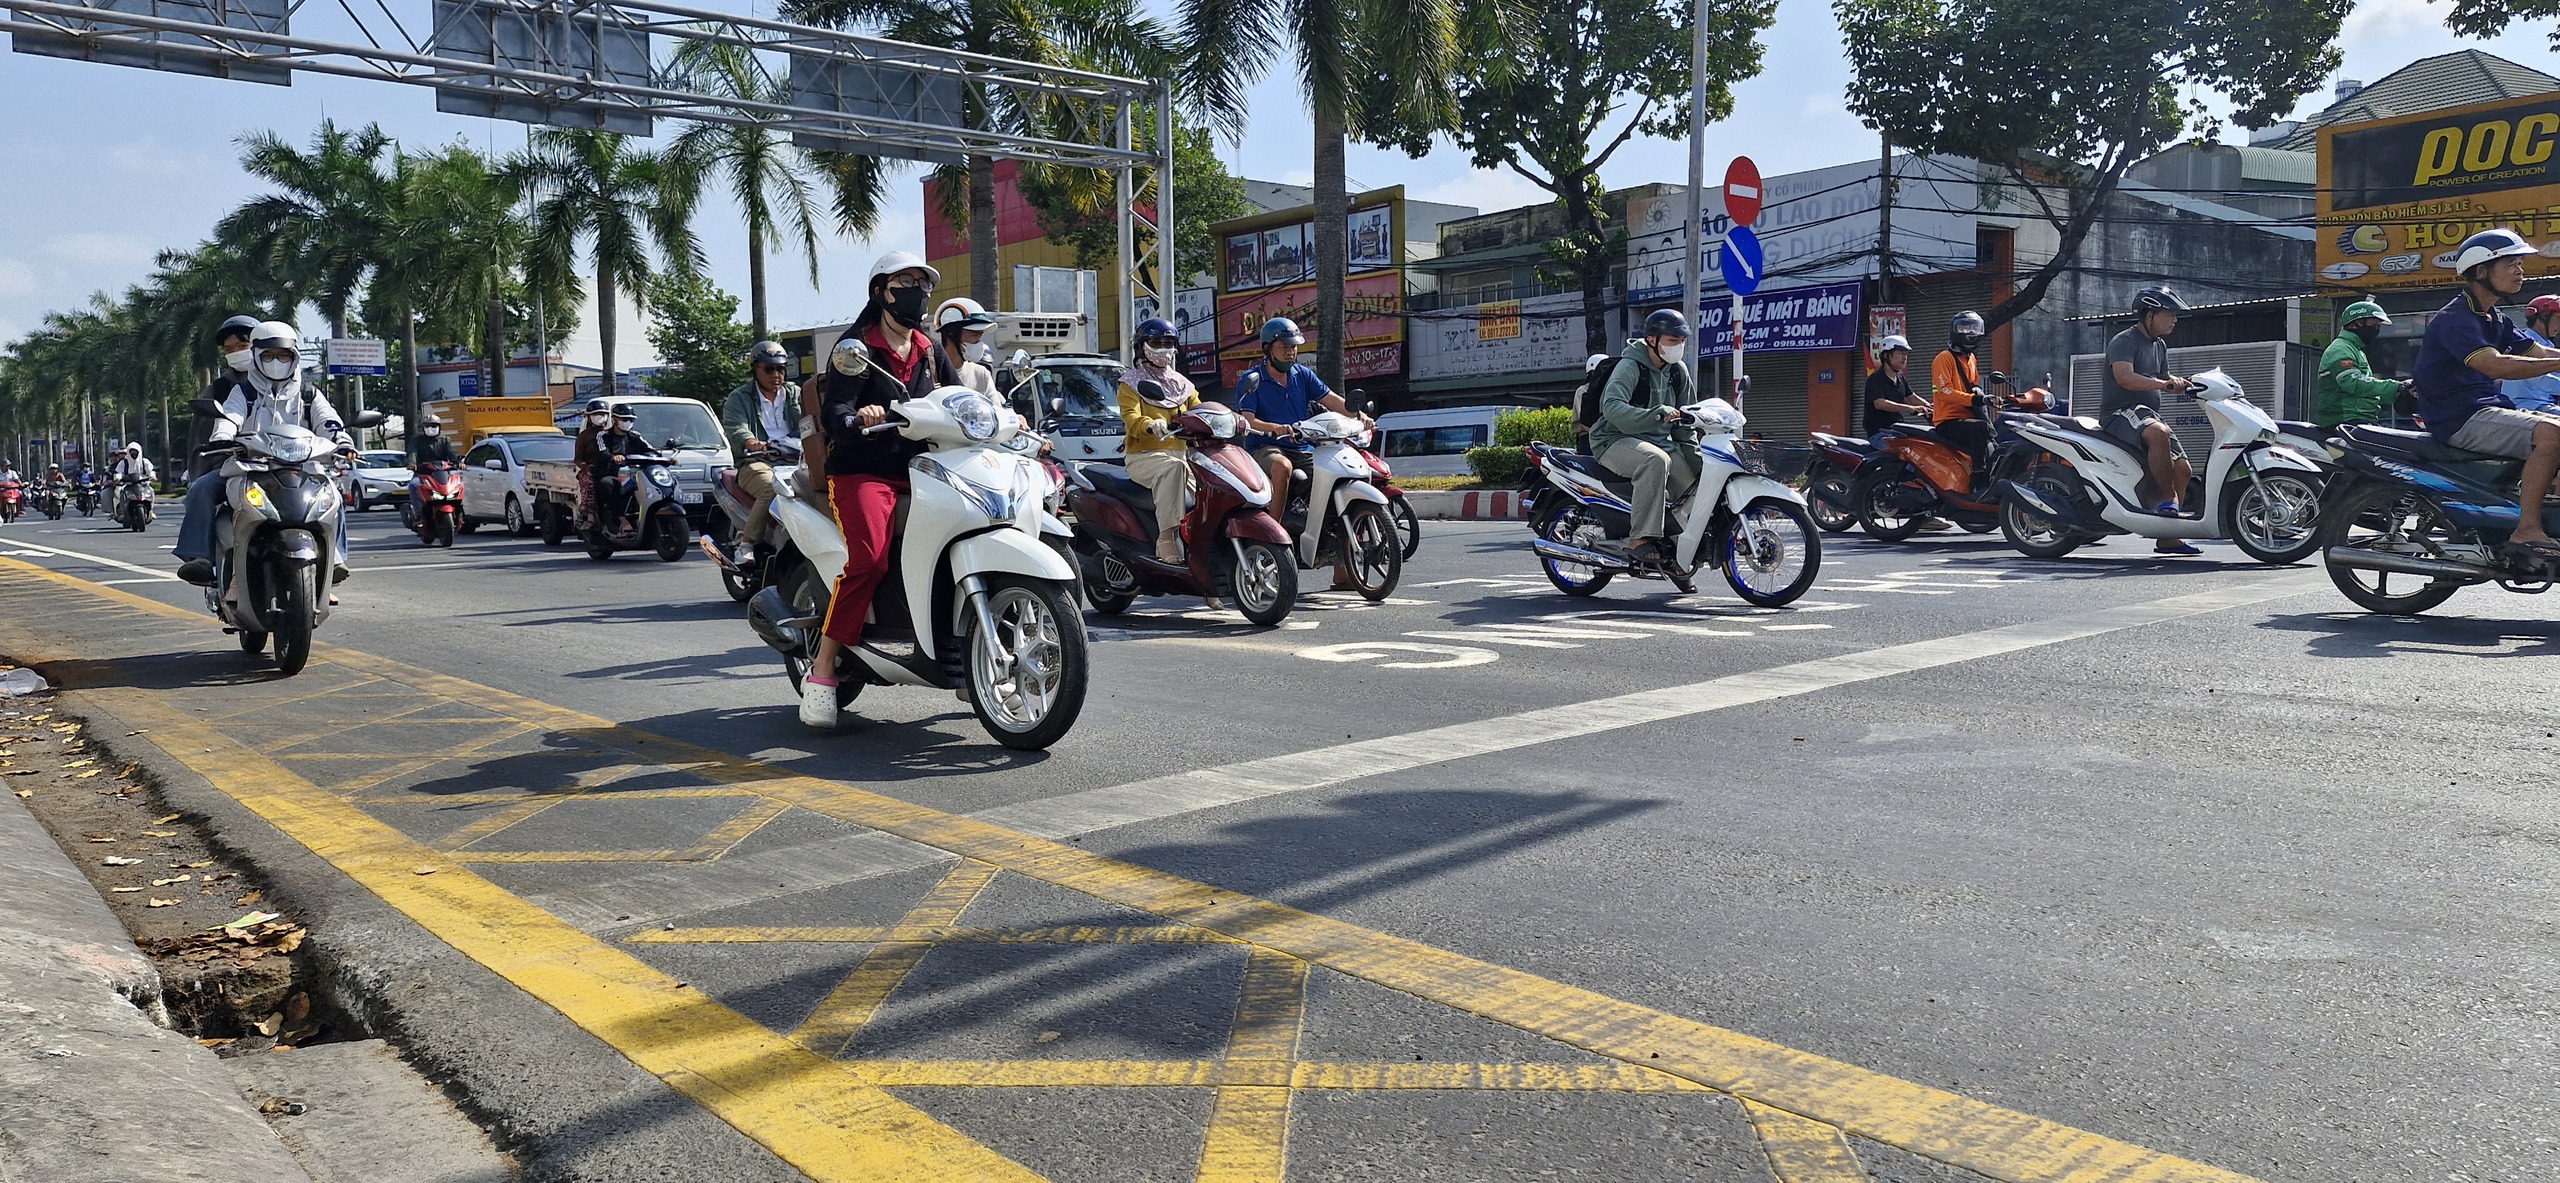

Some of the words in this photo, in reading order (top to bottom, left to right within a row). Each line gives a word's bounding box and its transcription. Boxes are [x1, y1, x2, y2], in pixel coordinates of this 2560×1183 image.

[2429, 175, 2470, 187] POWER
[2473, 173, 2487, 184] OF
[2488, 166, 2546, 181] CREATION
[1776, 199, 1822, 226] LAO
[1765, 295, 1804, 324] MẶT
[2349, 306, 2367, 317] Grab
[1783, 324, 1816, 338] 30M
[1773, 338, 1832, 349] 0919.925.431
[1820, 372, 1832, 381] 99
[467, 405, 486, 413] BƯU
[509, 405, 527, 413] VIỆT
[1091, 428, 1117, 436] ISUZU
